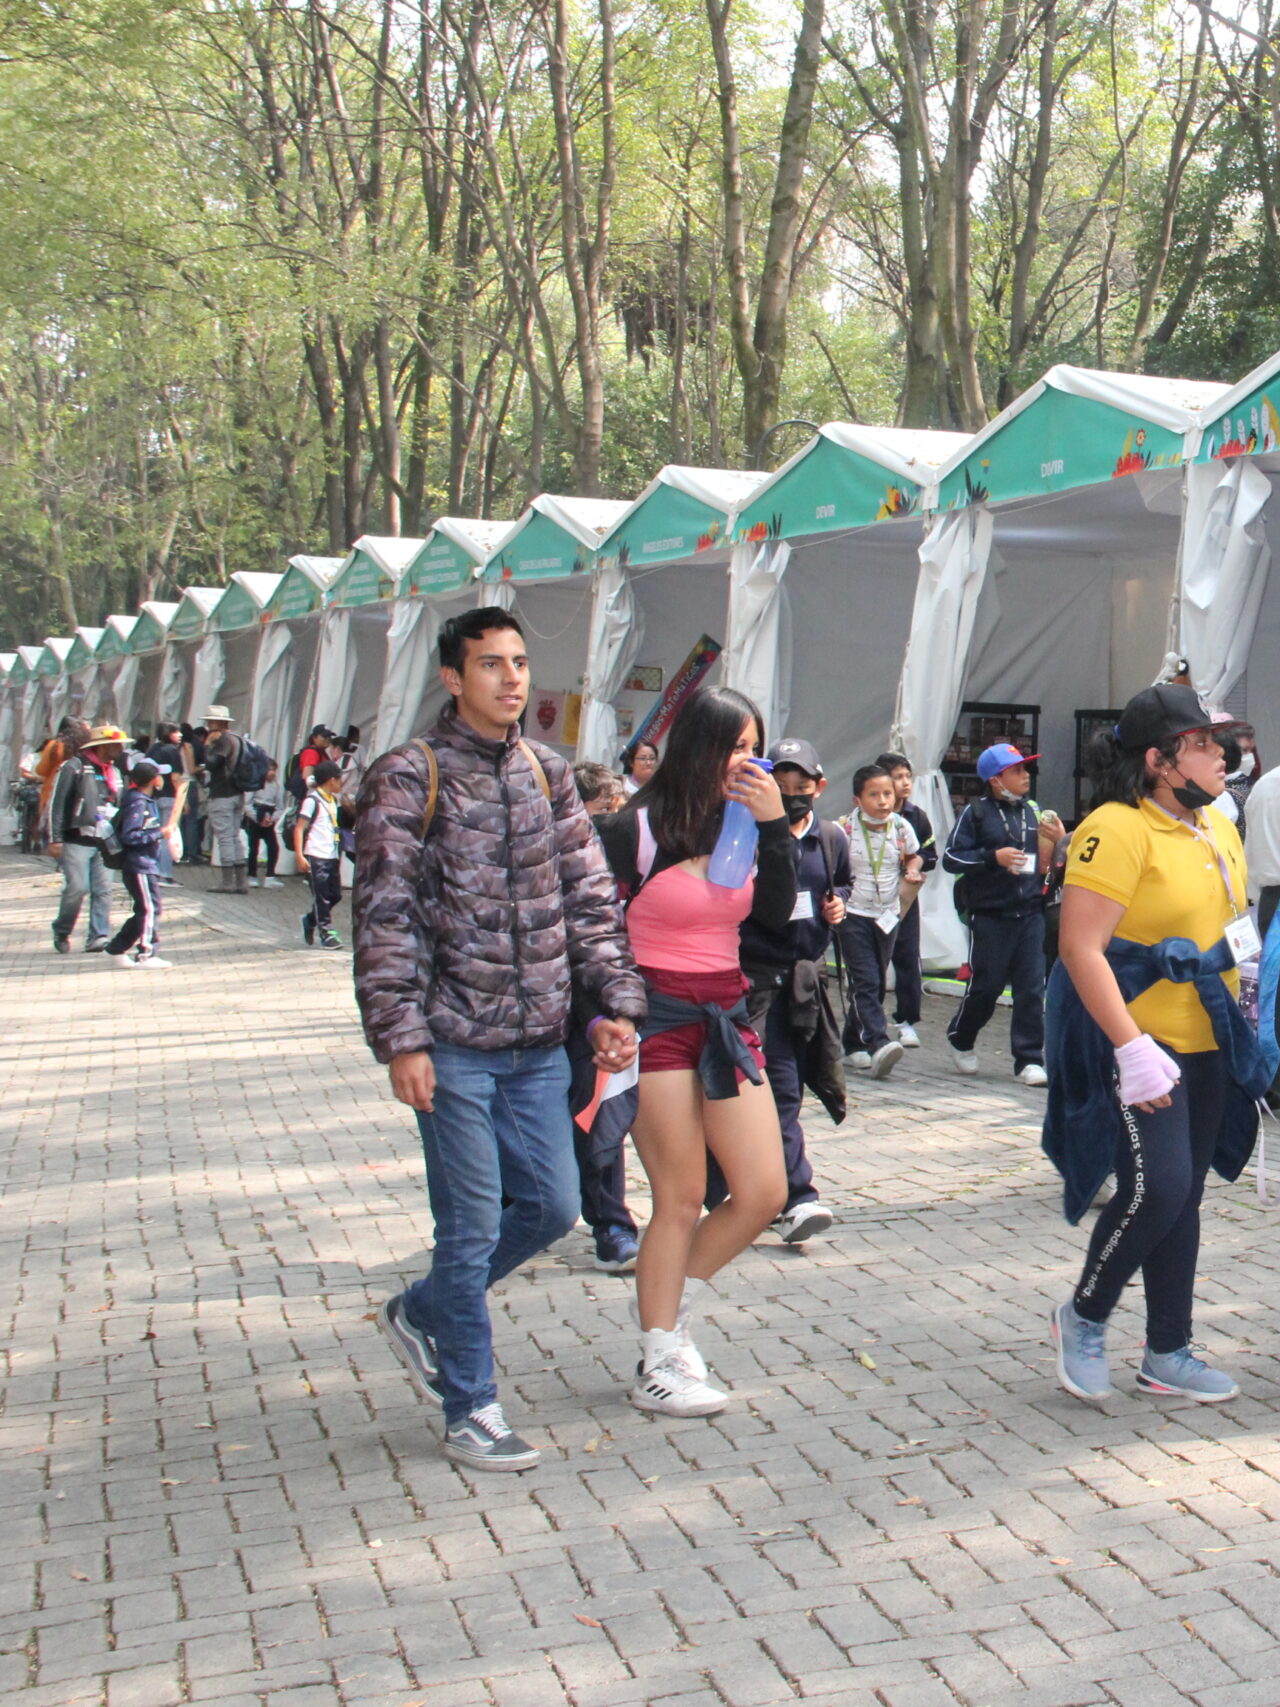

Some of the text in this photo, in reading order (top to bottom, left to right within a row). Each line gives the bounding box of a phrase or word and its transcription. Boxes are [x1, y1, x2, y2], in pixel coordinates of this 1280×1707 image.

[1079, 836, 1101, 864] 3
[1127, 1171, 1146, 1215] adidas
[1100, 1229, 1123, 1262] adidas
